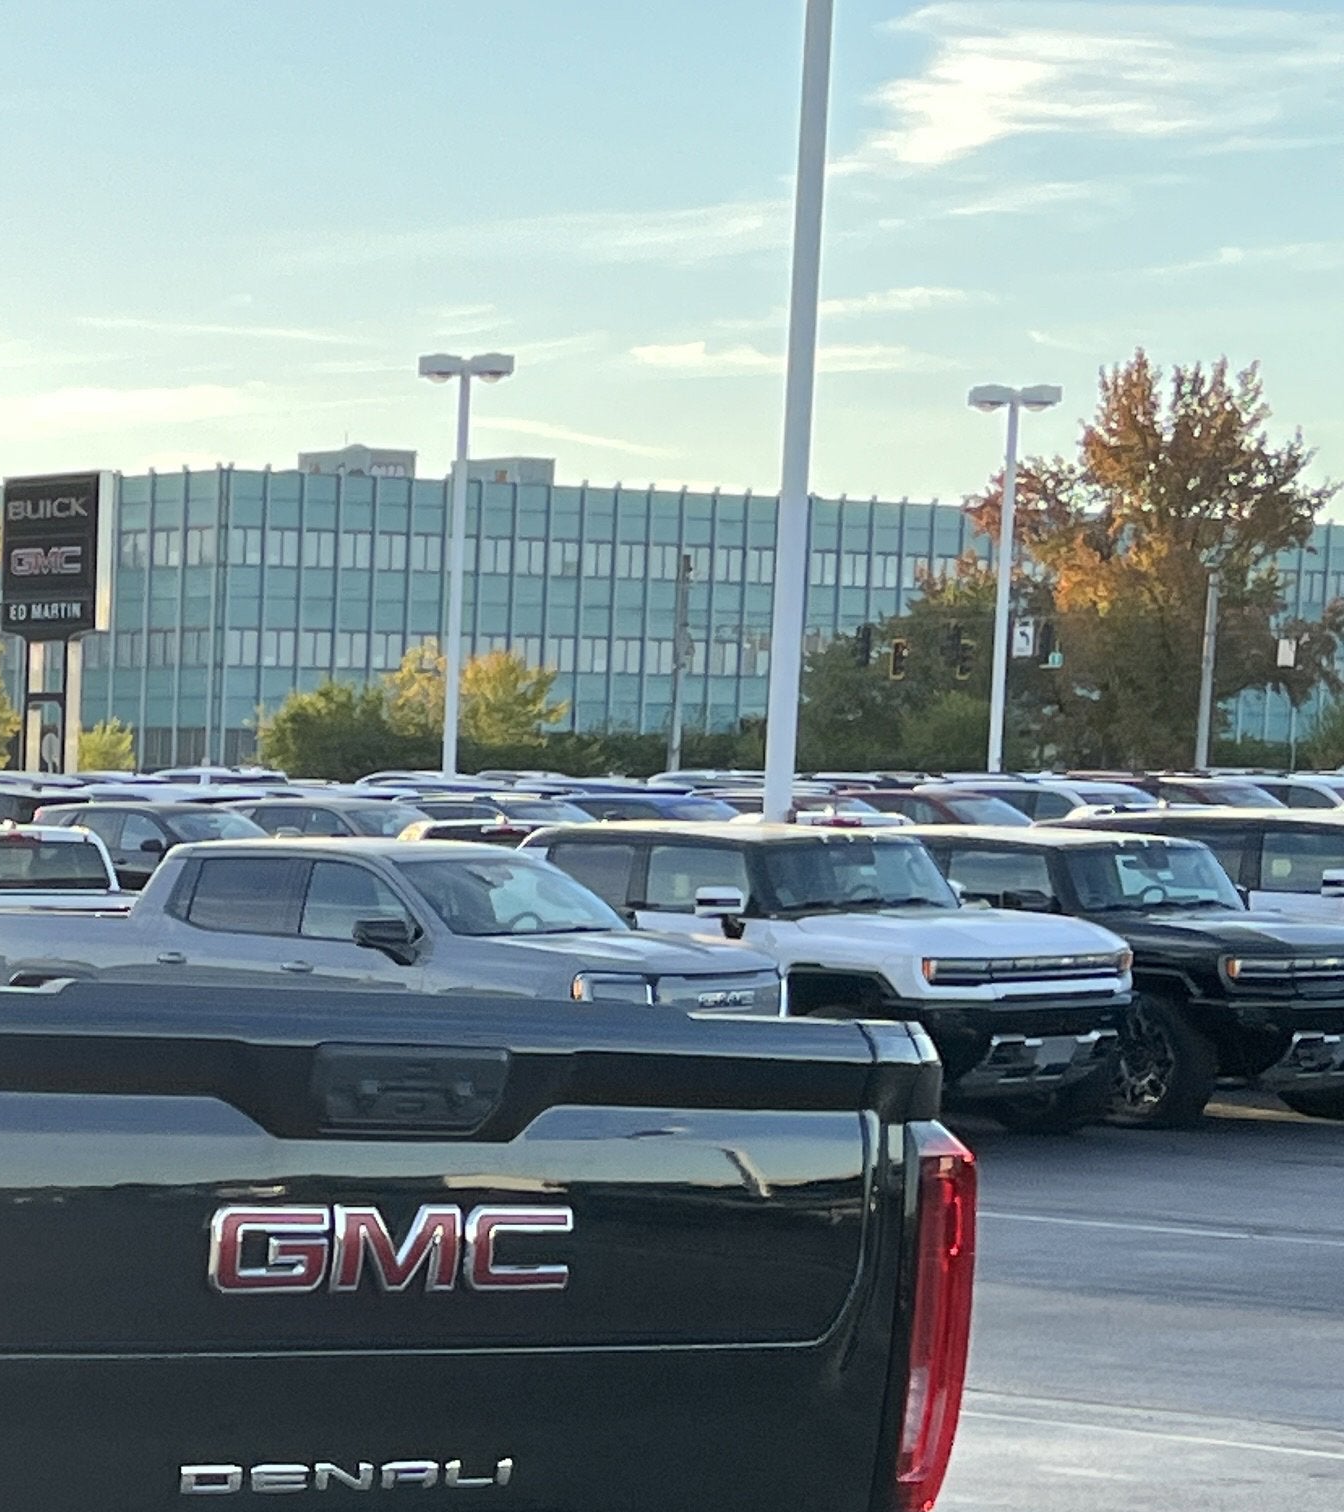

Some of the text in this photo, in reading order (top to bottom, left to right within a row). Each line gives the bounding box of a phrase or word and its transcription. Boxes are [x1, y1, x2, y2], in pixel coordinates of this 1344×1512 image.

[7, 497, 88, 521] BUICK
[11, 546, 82, 576] GMC
[9, 602, 81, 620] ED MARTIN
[210, 1203, 573, 1293] GMC
[180, 1457, 513, 1494] DENALI
